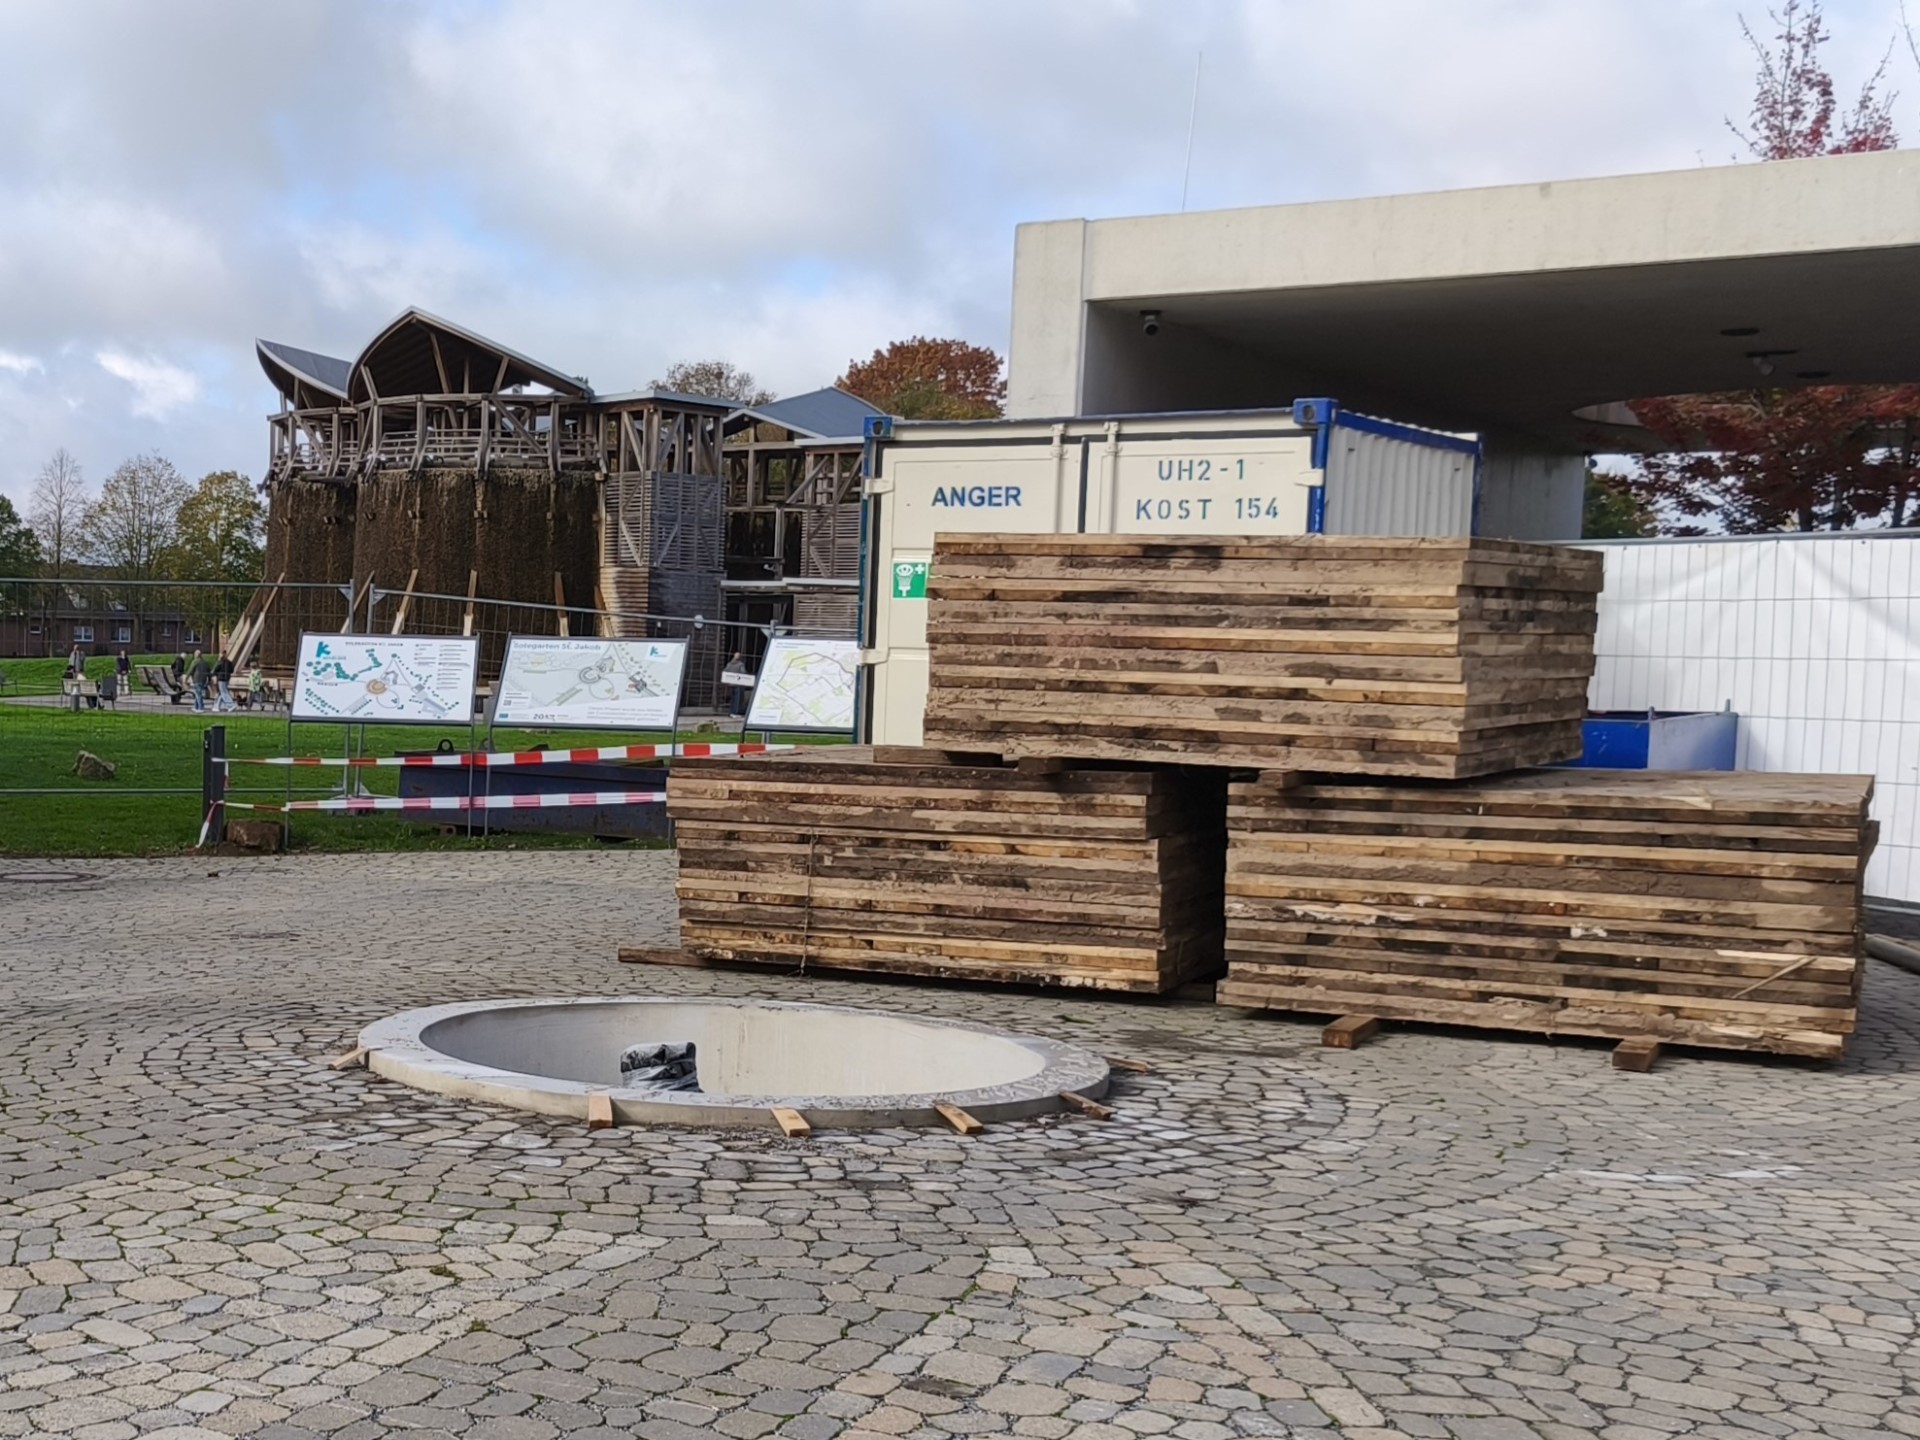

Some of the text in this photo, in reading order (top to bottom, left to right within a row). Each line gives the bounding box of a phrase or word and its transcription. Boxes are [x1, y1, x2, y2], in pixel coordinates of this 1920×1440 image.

[931, 486, 1022, 507] ANGER
[1136, 497, 1278, 520] KOST 154
